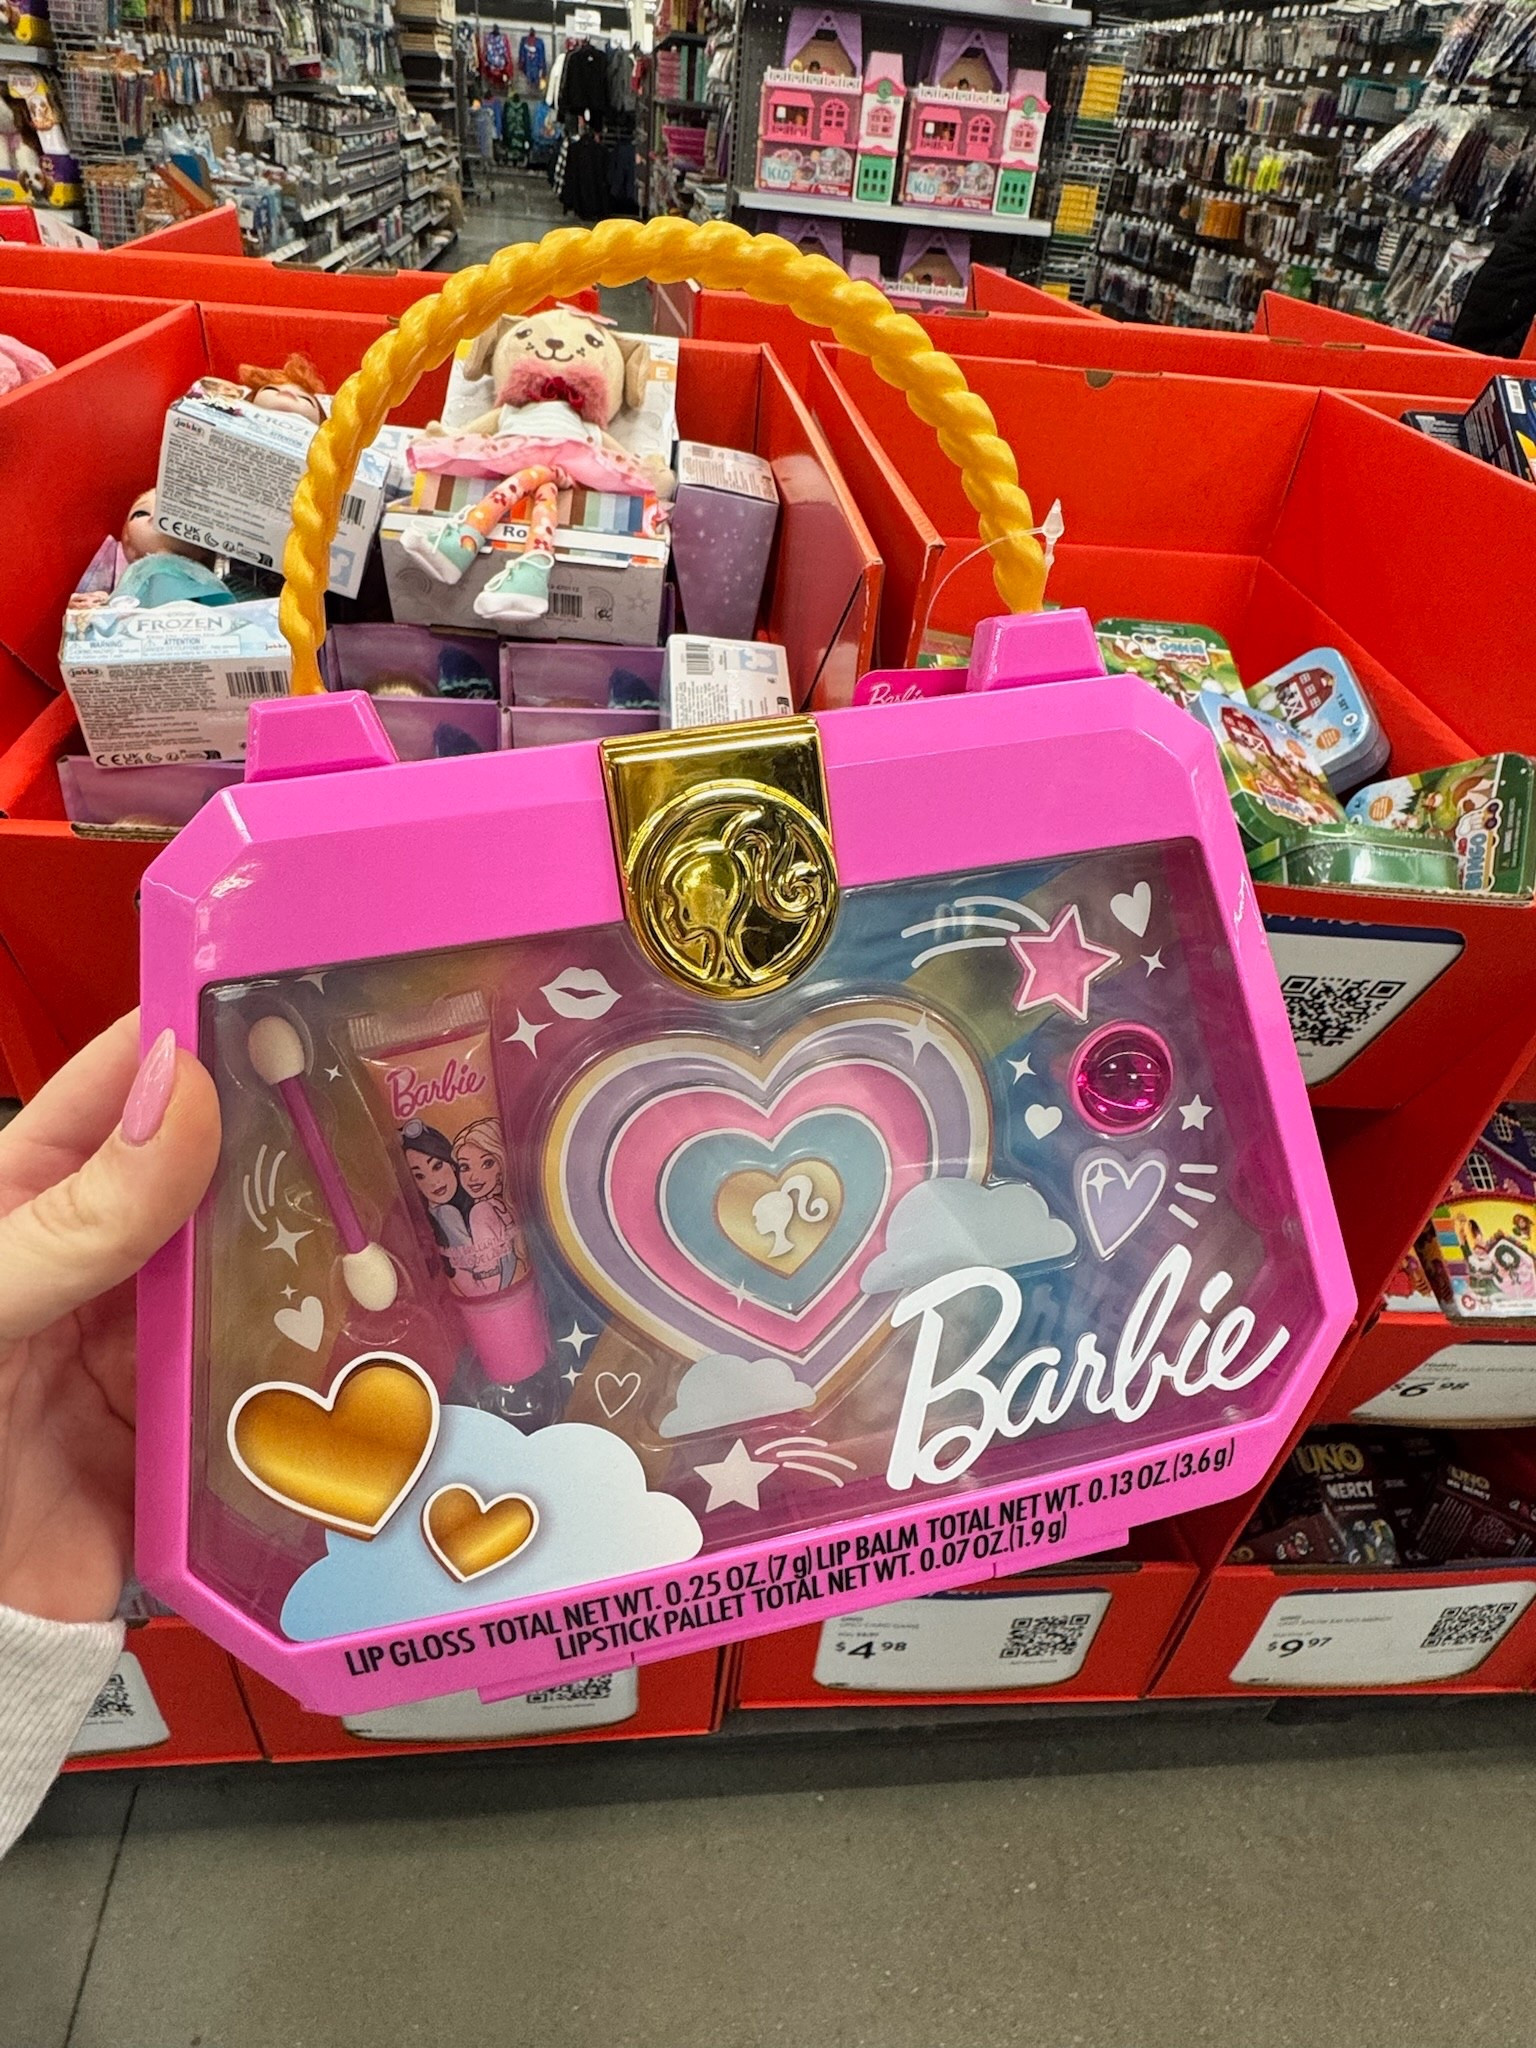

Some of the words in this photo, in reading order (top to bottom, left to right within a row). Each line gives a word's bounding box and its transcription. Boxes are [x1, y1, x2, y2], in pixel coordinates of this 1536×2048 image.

[503, 525, 528, 539] Ro
[136, 616, 224, 633] FROZEN
[1464, 832, 1488, 891] BINGO
[386, 1058, 487, 1118] Barbie
[886, 1243, 1291, 1490] Barbie
[1295, 1441, 1365, 1476] UNO
[1326, 1480, 1374, 1499] MERCY
[344, 1645, 385, 1676] LIP
[389, 1627, 476, 1668] GLOSS
[480, 1609, 562, 1648] TOTAL
[563, 1597, 610, 1631] NET
[614, 1586, 662, 1618] WT.
[665, 1571, 721, 1606] 0.25
[726, 1562, 767, 1591] OZ.
[817, 1540, 851, 1571] LIP
[855, 1523, 919, 1561] BALM
[926, 1506, 995, 1543] TOTAL
[999, 1493, 1042, 1527] NET
[1044, 1483, 1084, 1515] WT.
[1088, 1470, 1132, 1502] 0.13
[555, 1613, 662, 1661] LIPSTICK
[664, 1593, 747, 1635] PALLET
[752, 1575, 825, 1613] TOTAL
[828, 1563, 870, 1596] NET
[874, 1552, 916, 1583] WT.
[920, 1539, 969, 1572] 0.07
